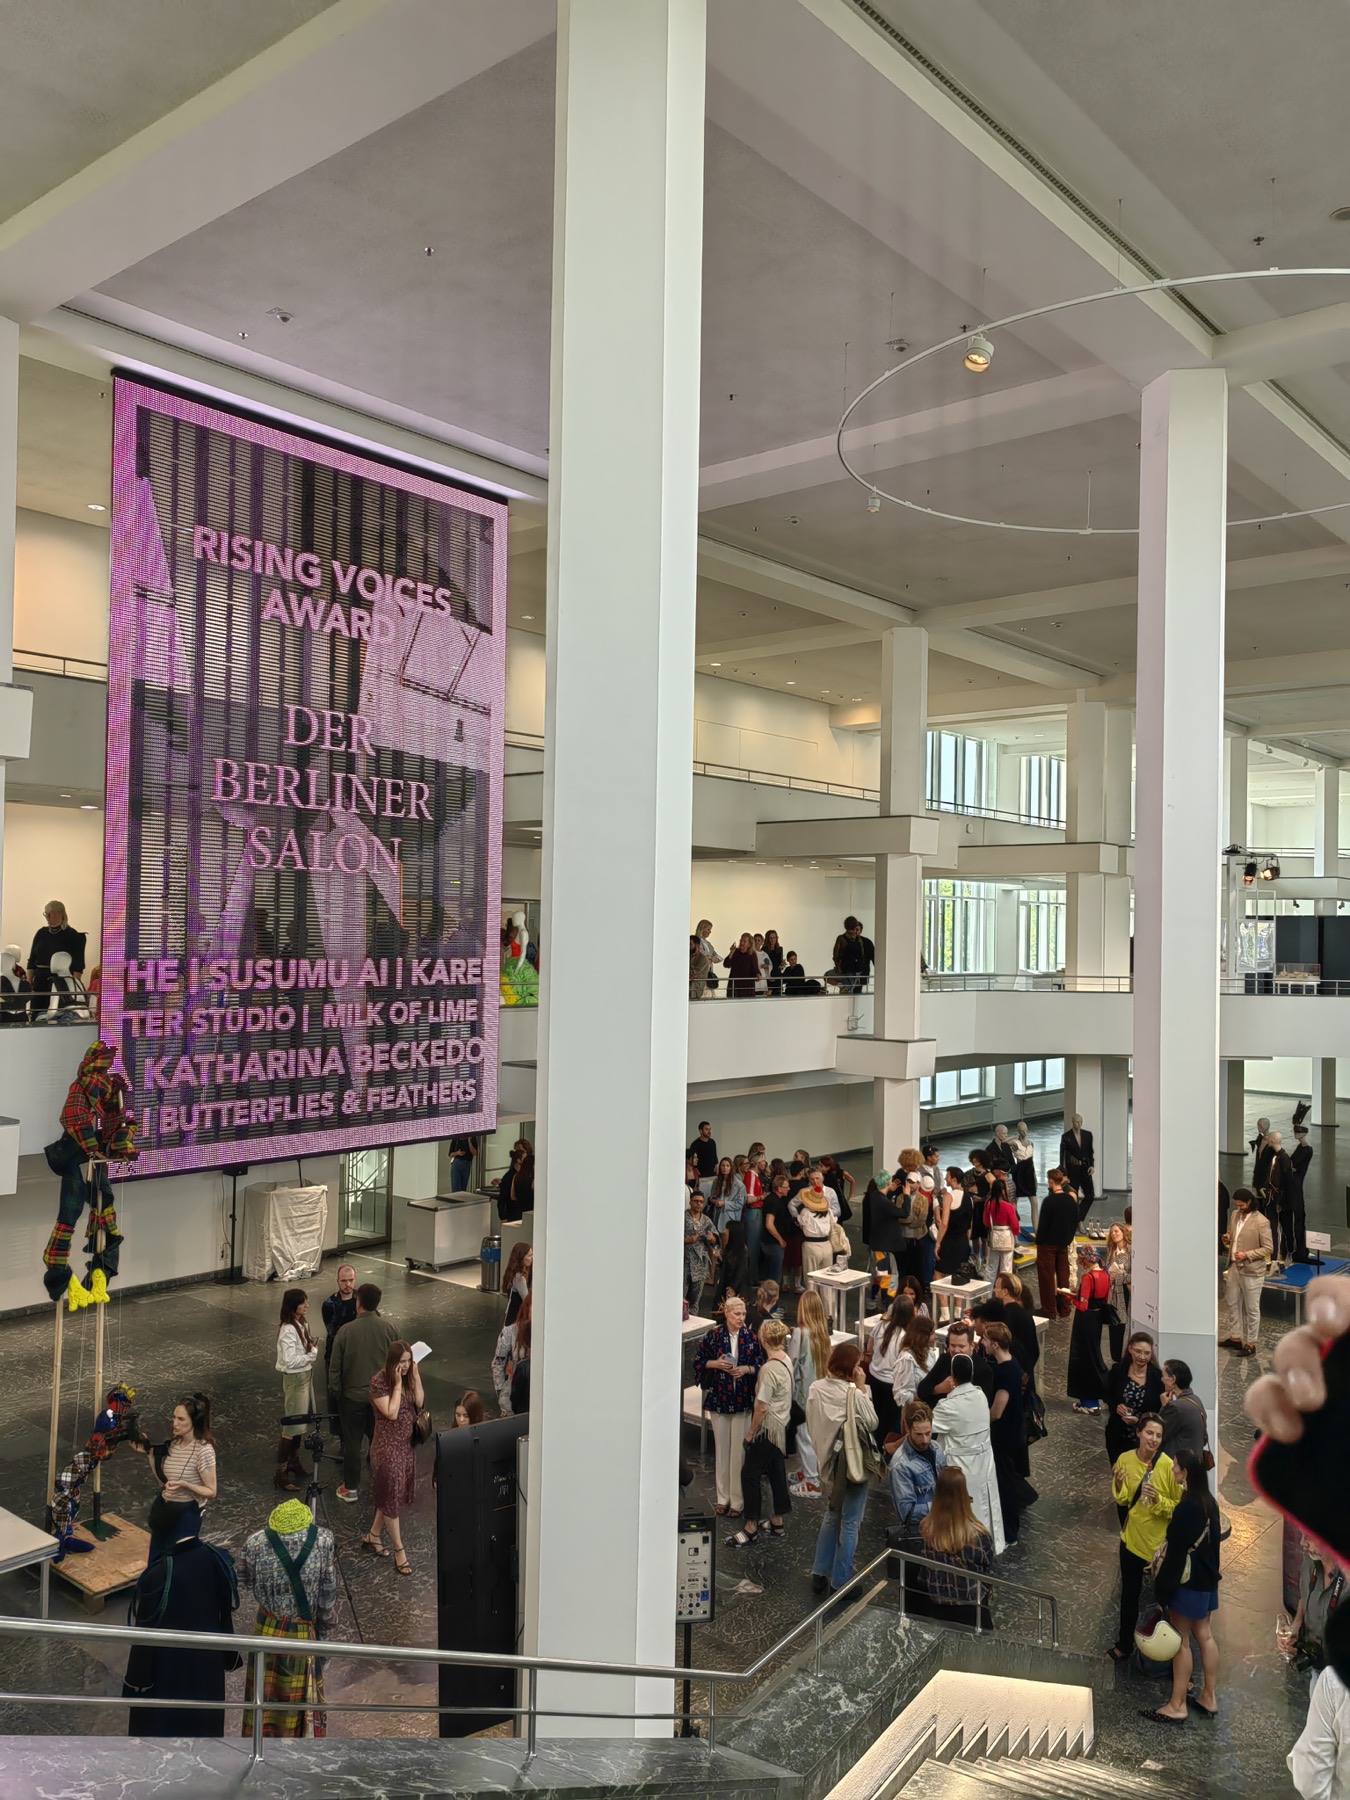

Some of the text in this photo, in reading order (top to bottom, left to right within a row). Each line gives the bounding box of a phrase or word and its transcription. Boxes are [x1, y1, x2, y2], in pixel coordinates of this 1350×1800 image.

[193, 525, 452, 616] RISING VOICES
[261, 590, 394, 643] AWARD
[284, 705, 375, 756] DER
[211, 759, 432, 820] BERLINER
[248, 827, 401, 874] SALON
[207, 958, 348, 990] SUSUMU
[357, 957, 388, 987] AI
[192, 1005, 296, 1035] STUDIO
[323, 1002, 384, 1028] MILK
[389, 1000, 422, 1024] OF
[428, 999, 478, 1023] LIME
[143, 1036, 483, 1090] KATHARINA BECKEDO
[160, 1092, 335, 1134] BUTTERFLIES
[341, 1089, 361, 1114] &
[366, 1079, 477, 1112] FEATHERS
